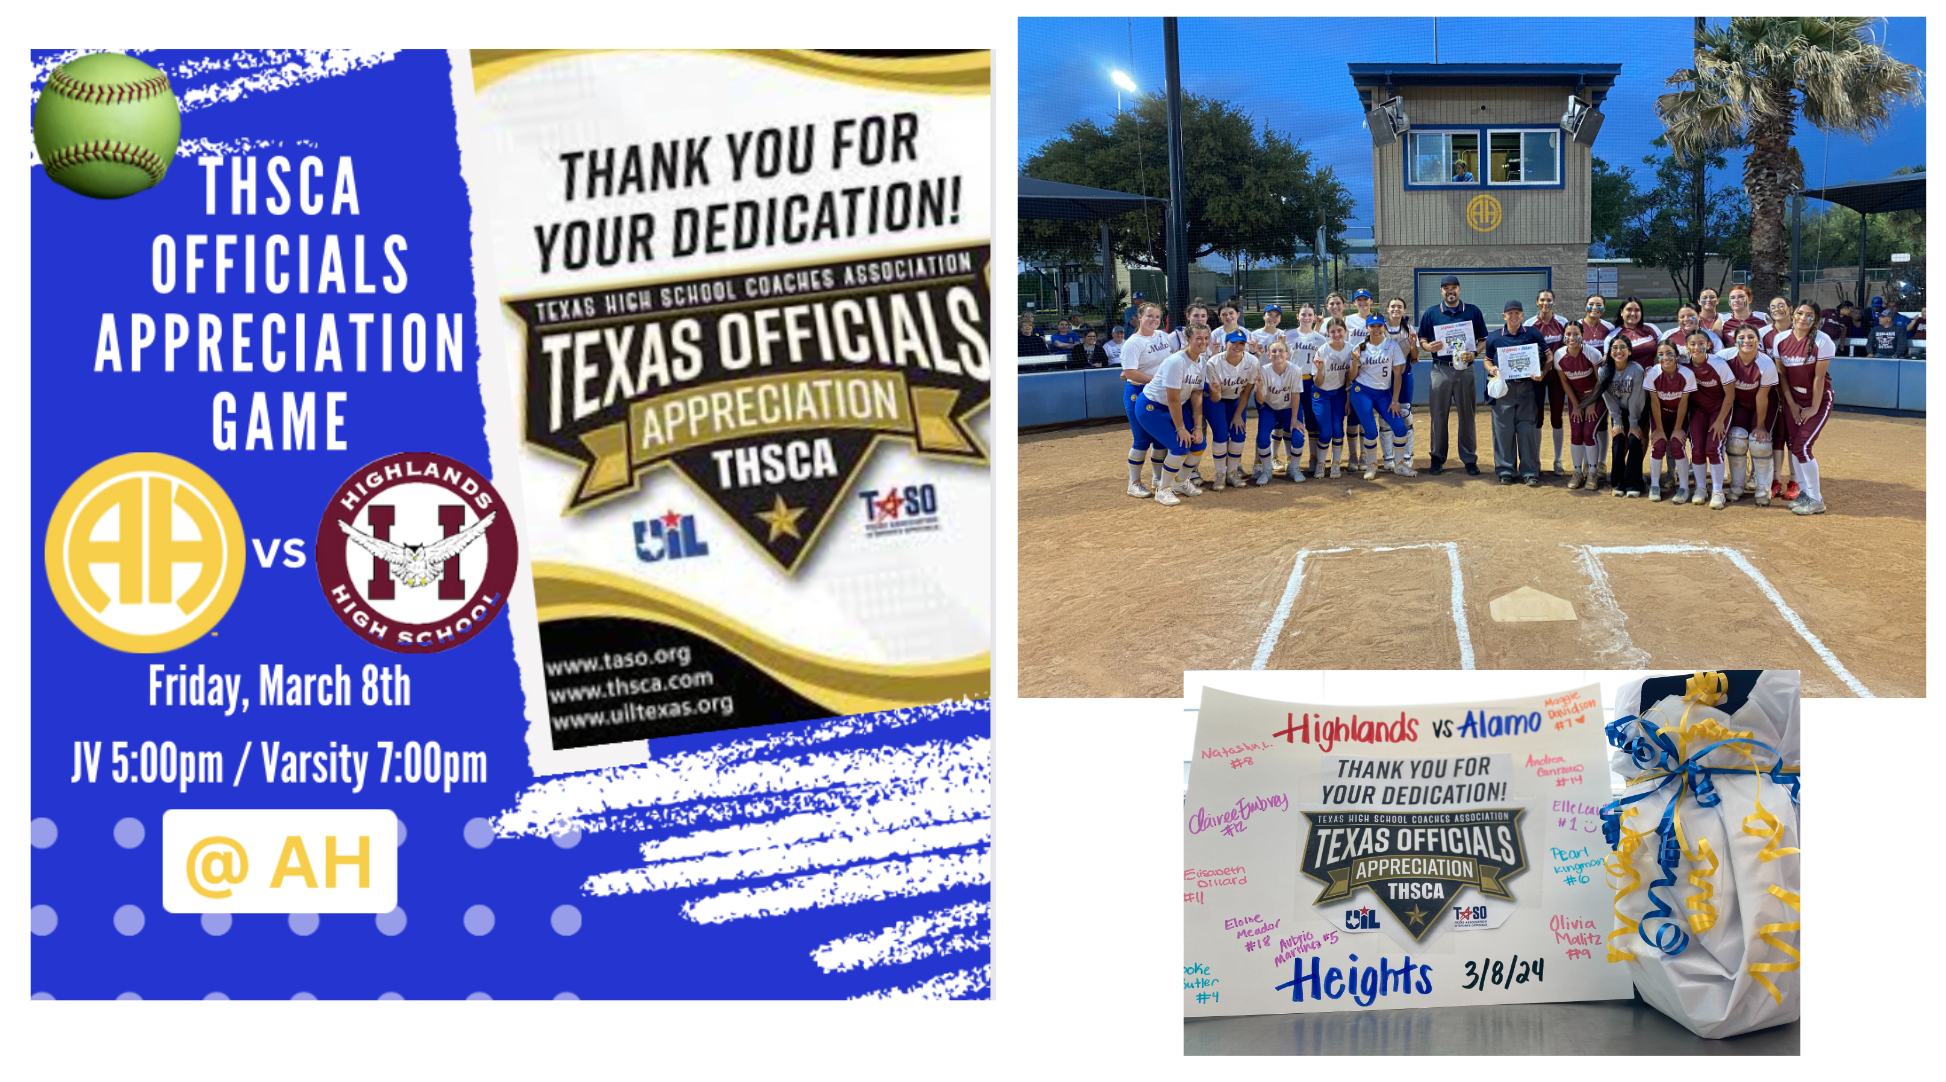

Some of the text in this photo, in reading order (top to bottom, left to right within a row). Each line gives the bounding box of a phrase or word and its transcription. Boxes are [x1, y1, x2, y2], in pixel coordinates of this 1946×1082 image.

[559, 111, 919, 202] THANK YOU FOR
[198, 156, 360, 215] THSCA
[534, 174, 963, 274] YOUR DEDICATION!
[152, 234, 408, 295] OFFICIALS
[536, 251, 973, 324] TEXAS HIGH SCHOOL COACHES ASSOCIATION
[94, 313, 463, 373] APPRECIATION
[541, 286, 990, 434] TEXAS OFFICIALS
[1362, 356, 1389, 366] Mules
[1382, 366, 1388, 377] 5
[212, 391, 348, 451] GAME
[640, 378, 899, 450] APPRECIATION
[712, 438, 838, 489] THSCA
[340, 461, 493, 511] HIGHLANDS
[332, 584, 501, 646] HIGH SCHOOL
[545, 645, 692, 678] www.taso.org
[149, 664, 411, 717] Friday, March 8th
[548, 670, 714, 705] www.thsca.com
[1544, 691, 1581, 708] Maggie
[551, 695, 735, 732] www.uiltexas.org
[1547, 699, 1596, 720] Davidson
[1272, 711, 1419, 753] Highlands
[1456, 709, 1542, 739] Alamo
[71, 741, 488, 793] JV 5:00pm / Varsity 7:00pm
[1230, 756, 1254, 769] #8
[1338, 756, 1491, 779] THANK YOU FOR
[1556, 774, 1583, 787] #14
[1322, 781, 1507, 806] YOUR DEDICATION!
[1553, 800, 1576, 814] Elle
[1318, 812, 1509, 824] TEXAS HIGH SCHOOL COACHES ASSOCIATION
[1314, 825, 1516, 870] TEXAS OFFICIALS
[186, 835, 370, 899] @ AH
[1355, 858, 1474, 880] APPRECIATION
[1563, 874, 1590, 886] #6
[1387, 882, 1445, 900] THSCA
[1322, 930, 1339, 945] #5
[1550, 914, 1596, 932] Olivia
[1244, 935, 1271, 952] #18
[1275, 953, 1433, 1007] Heights
[1462, 954, 1545, 992] 3/8/24
[1195, 991, 1219, 1004] #4
